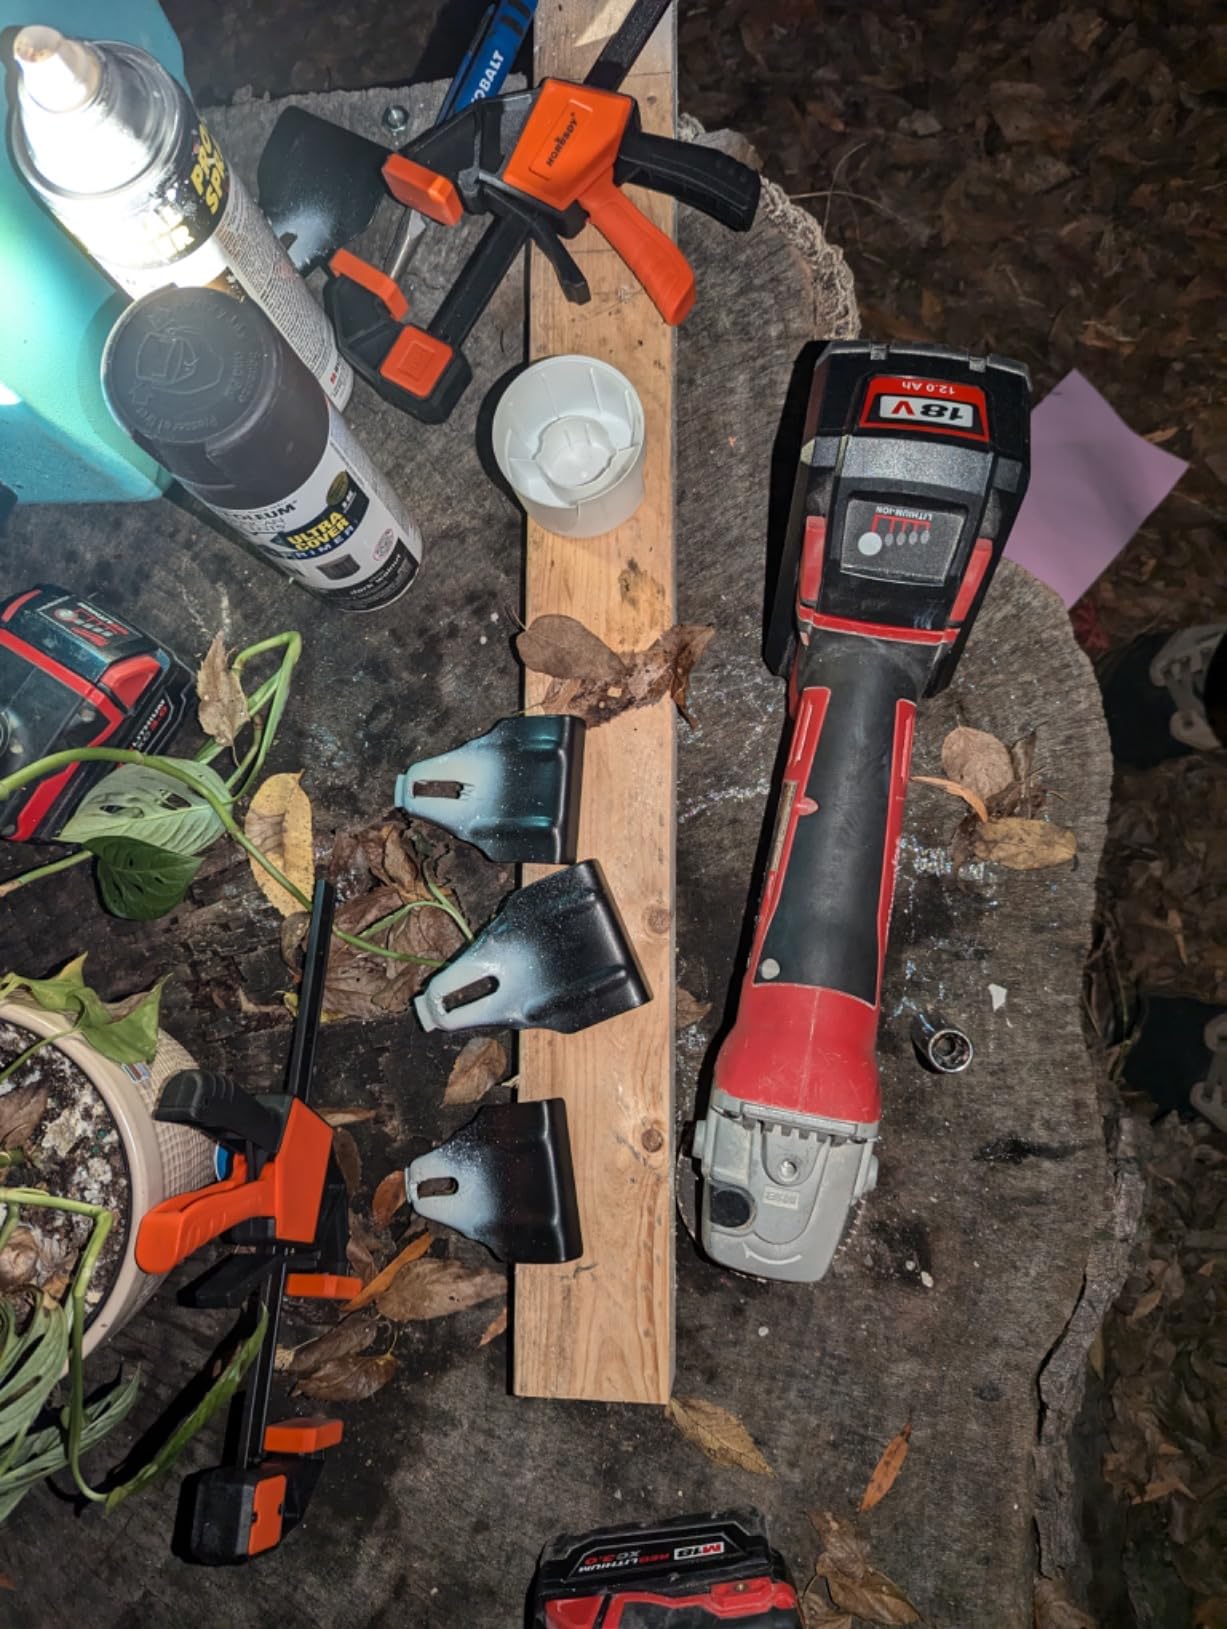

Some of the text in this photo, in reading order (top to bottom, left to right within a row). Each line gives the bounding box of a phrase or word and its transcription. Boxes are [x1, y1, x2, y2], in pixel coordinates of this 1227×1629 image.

[470, 49, 505, 104] OBALT
[190, 123, 213, 196] PRO
[901, 380, 956, 395] 12.0 Ah
[890, 399, 965, 421] 18V
[287, 511, 343, 544] ULTRA
[875, 505, 934, 521] LITHIUM-ION
[294, 518, 350, 551] COVER
